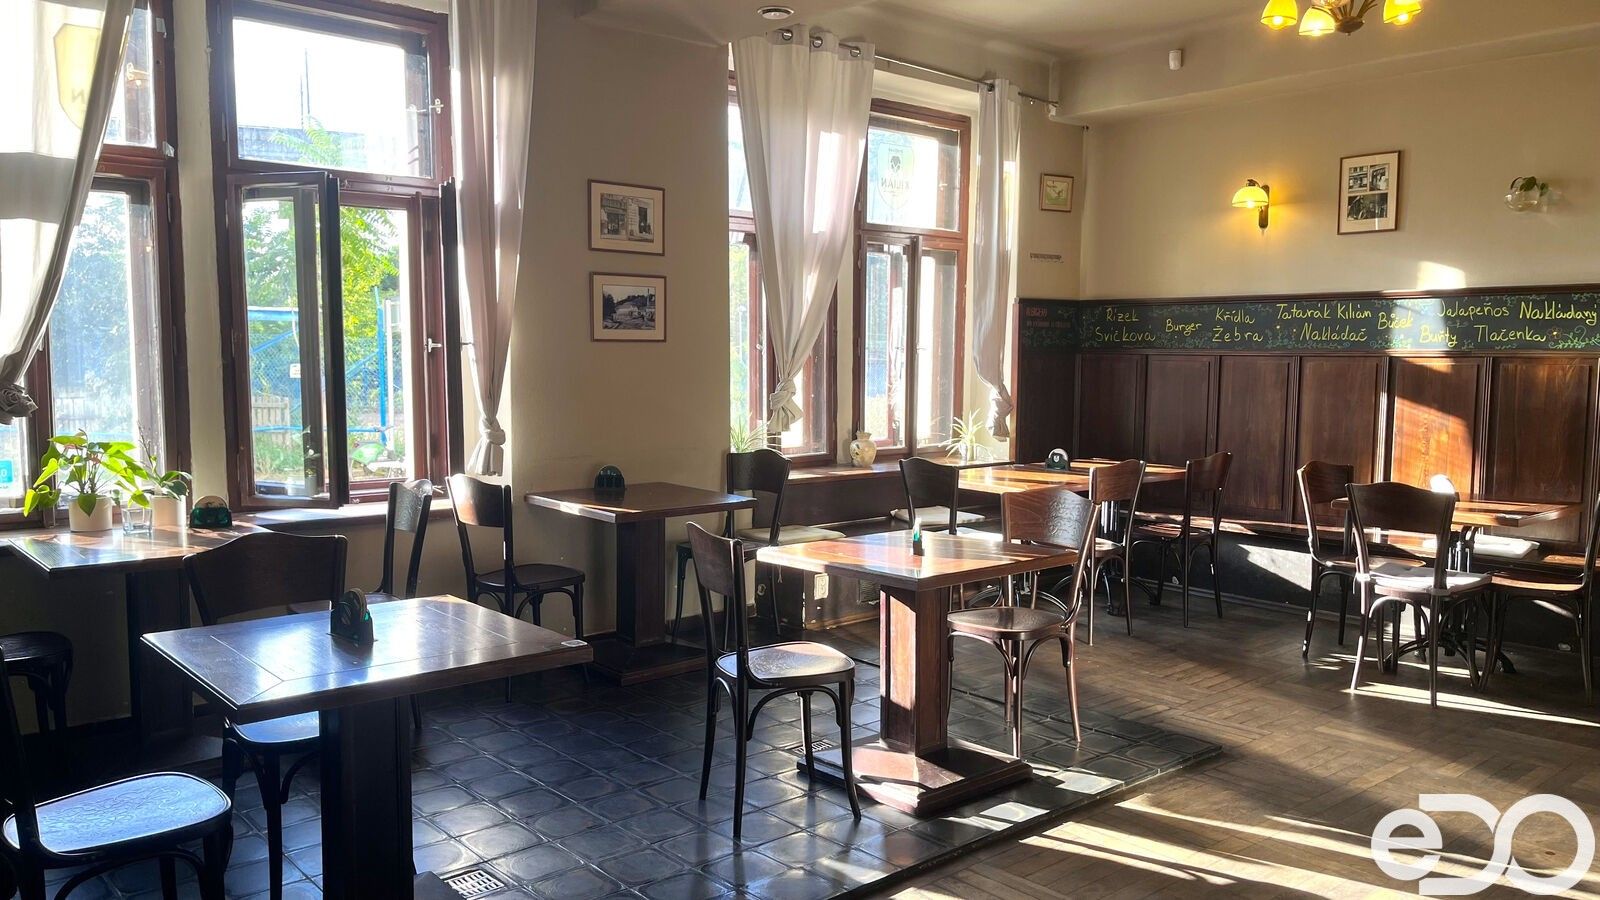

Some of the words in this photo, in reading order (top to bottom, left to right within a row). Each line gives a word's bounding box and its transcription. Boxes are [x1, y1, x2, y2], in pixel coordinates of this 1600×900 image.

[1215, 307, 1256, 324] Křídla
[1276, 303, 1332, 320] Tatarák
[1436, 299, 1510, 320] Jalapeños
[1519, 300, 1598, 326] Nakládaný
[1165, 319, 1202, 337] Burger
[1212, 325, 1264, 342] Žebra
[1299, 322, 1368, 341] Nakládač
[1473, 325, 1547, 343] Tlačenka
